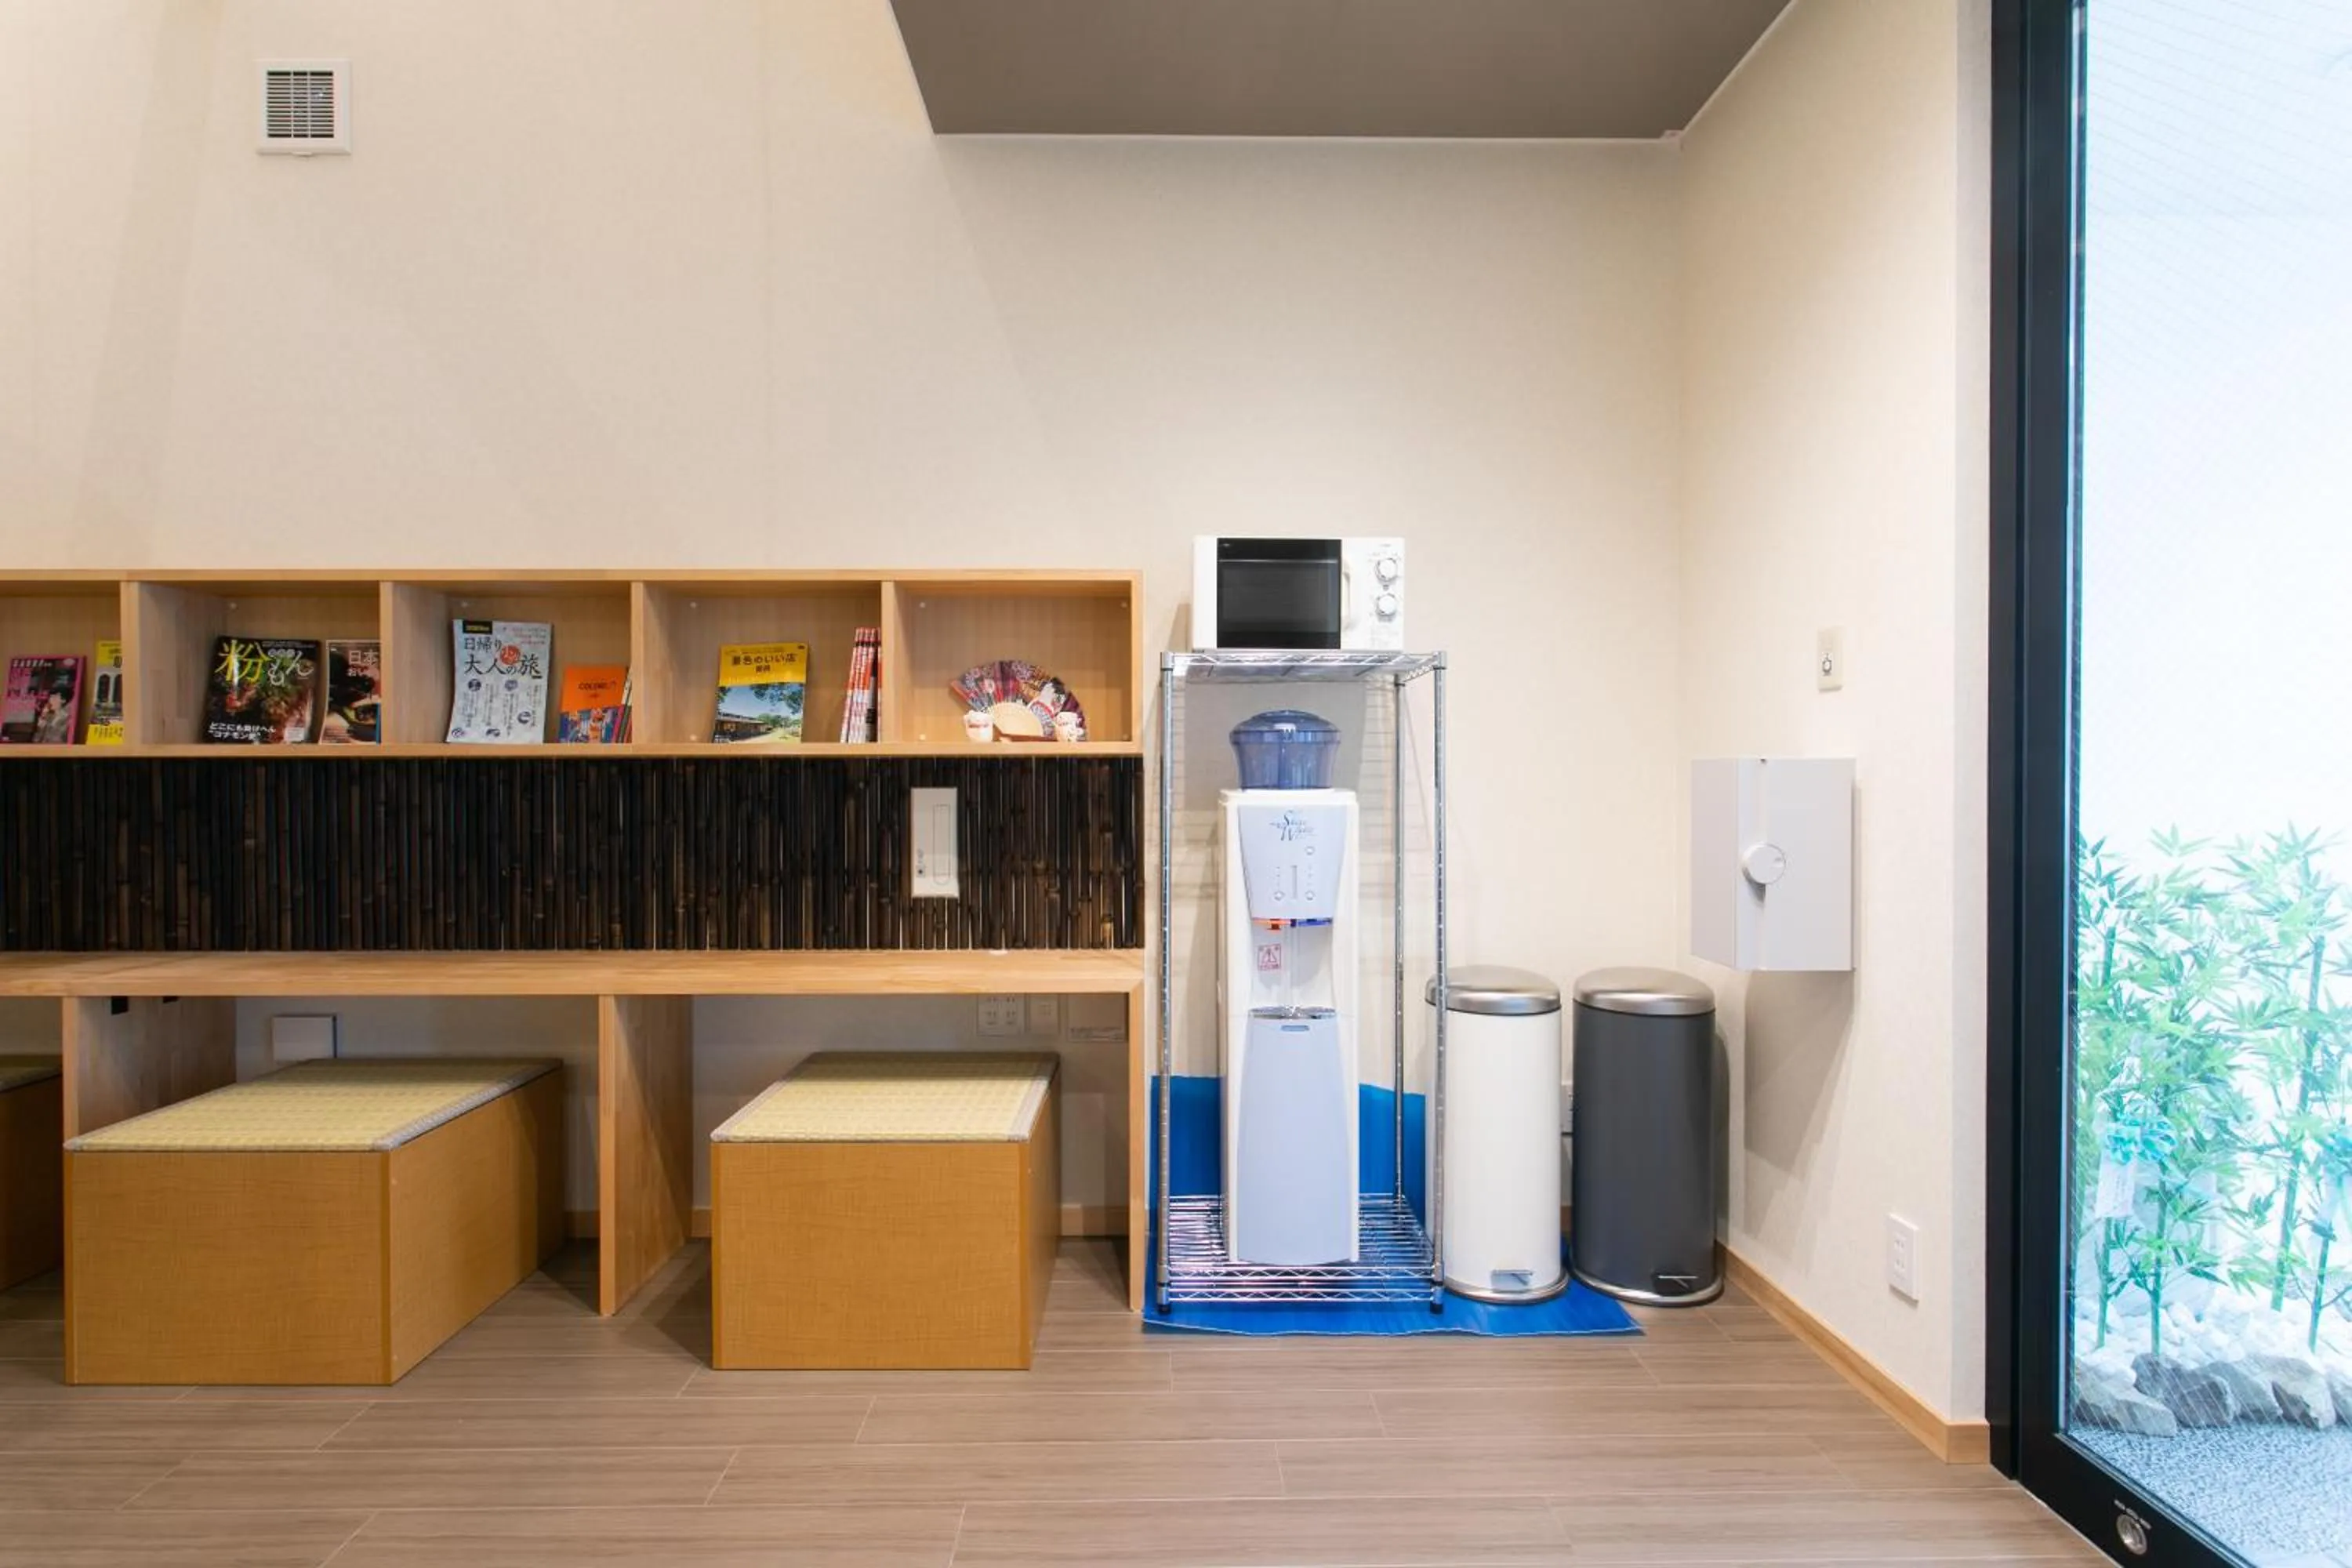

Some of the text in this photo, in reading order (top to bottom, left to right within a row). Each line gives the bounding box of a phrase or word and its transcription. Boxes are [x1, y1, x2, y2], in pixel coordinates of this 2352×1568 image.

[464, 637, 503, 652] 日帰り
[215, 639, 314, 686] 粉もん
[348, 649, 379, 666] 日本
[465, 654, 541, 675] 大人の旅
